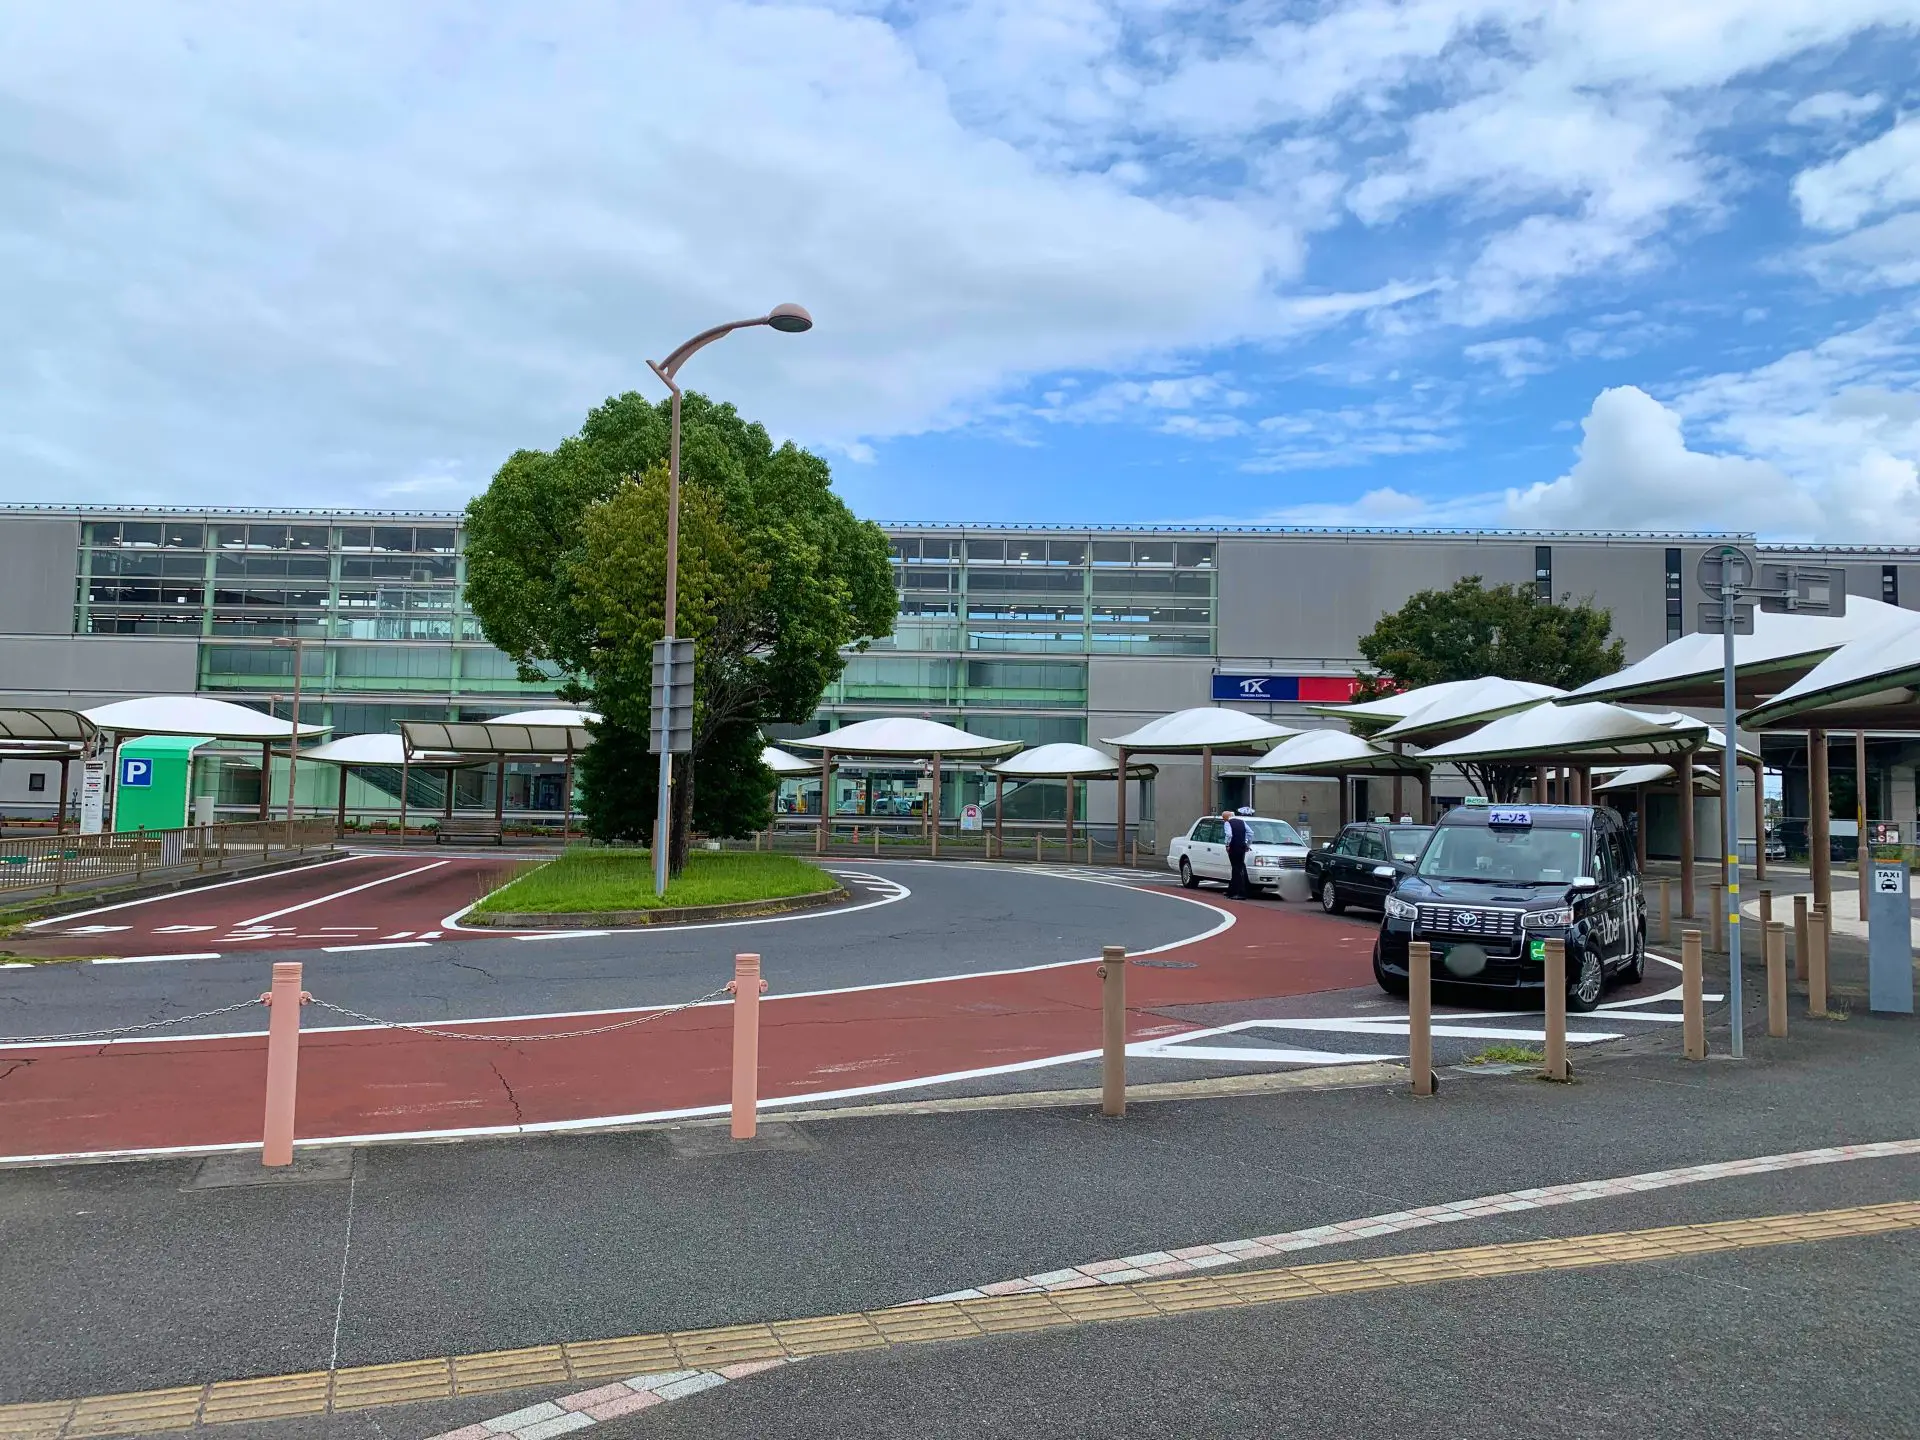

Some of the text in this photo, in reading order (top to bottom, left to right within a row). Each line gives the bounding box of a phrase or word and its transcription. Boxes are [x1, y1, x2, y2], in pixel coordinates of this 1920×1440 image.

[1240, 679, 1270, 692] TX
[127, 761, 147, 782] P
[1491, 812, 1527, 823] オーソネ
[1601, 912, 1620, 945] Uber
